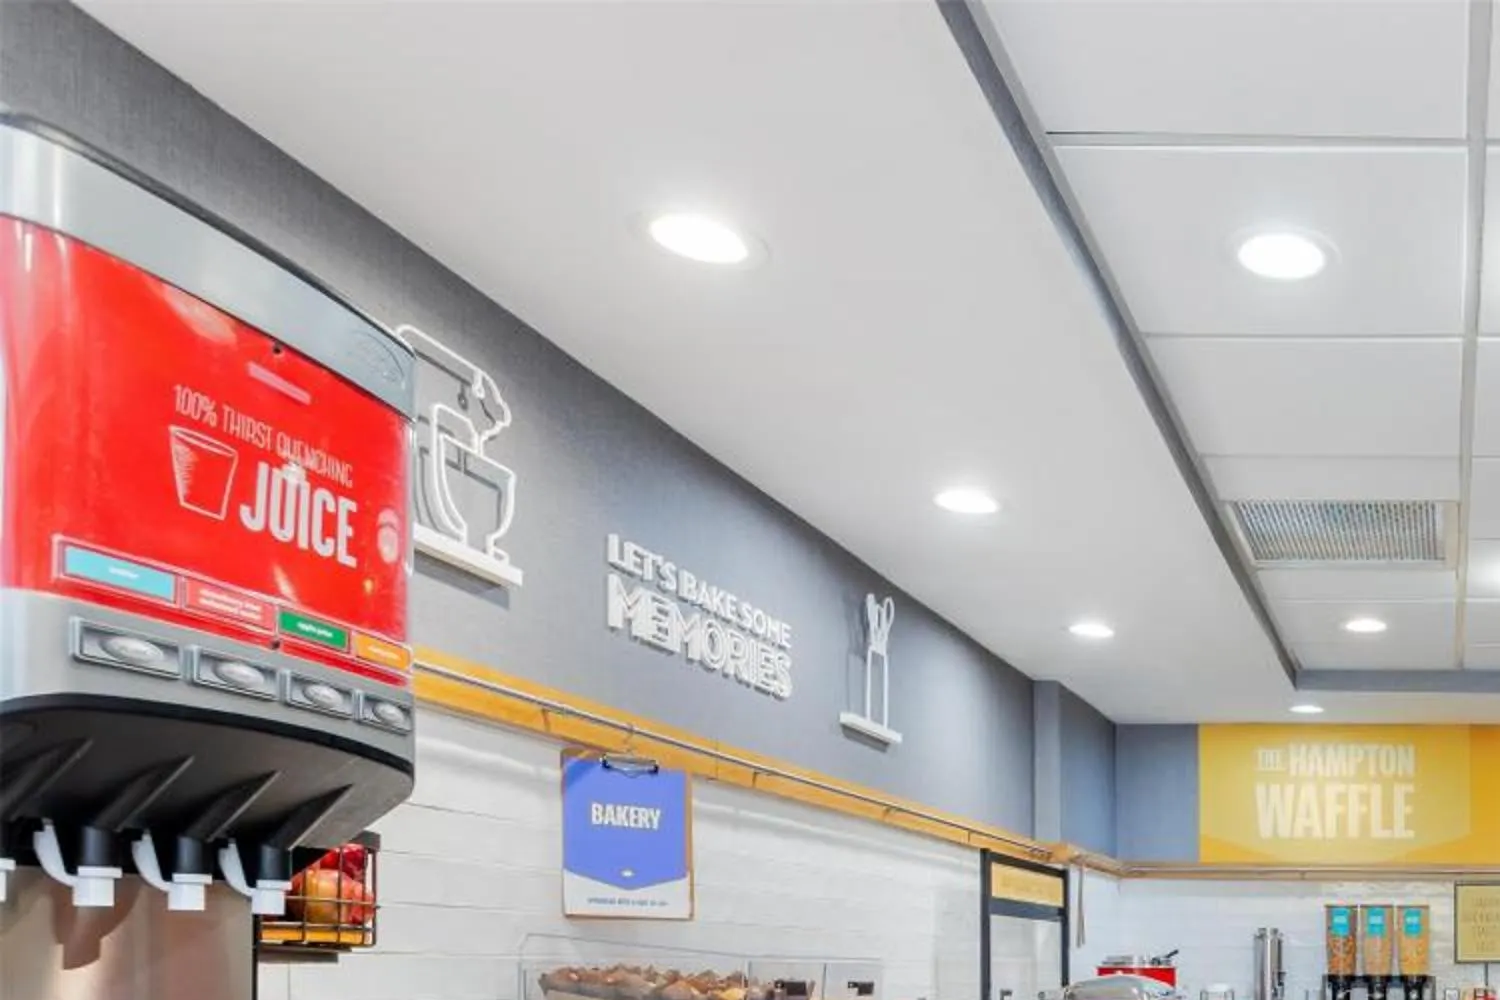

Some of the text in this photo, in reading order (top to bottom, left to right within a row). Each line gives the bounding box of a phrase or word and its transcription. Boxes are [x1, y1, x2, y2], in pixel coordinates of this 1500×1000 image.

[174, 385, 353, 488] 100% THIRST QUENCHING
[239, 461, 358, 569] JUICE
[607, 533, 792, 649] LET'S BAKE SOME
[607, 573, 793, 699] MEMORIES
[1256, 783, 1415, 838] WAFFLE
[1289, 743, 1415, 777] HAMPTON
[591, 803, 661, 830] BAKERY
